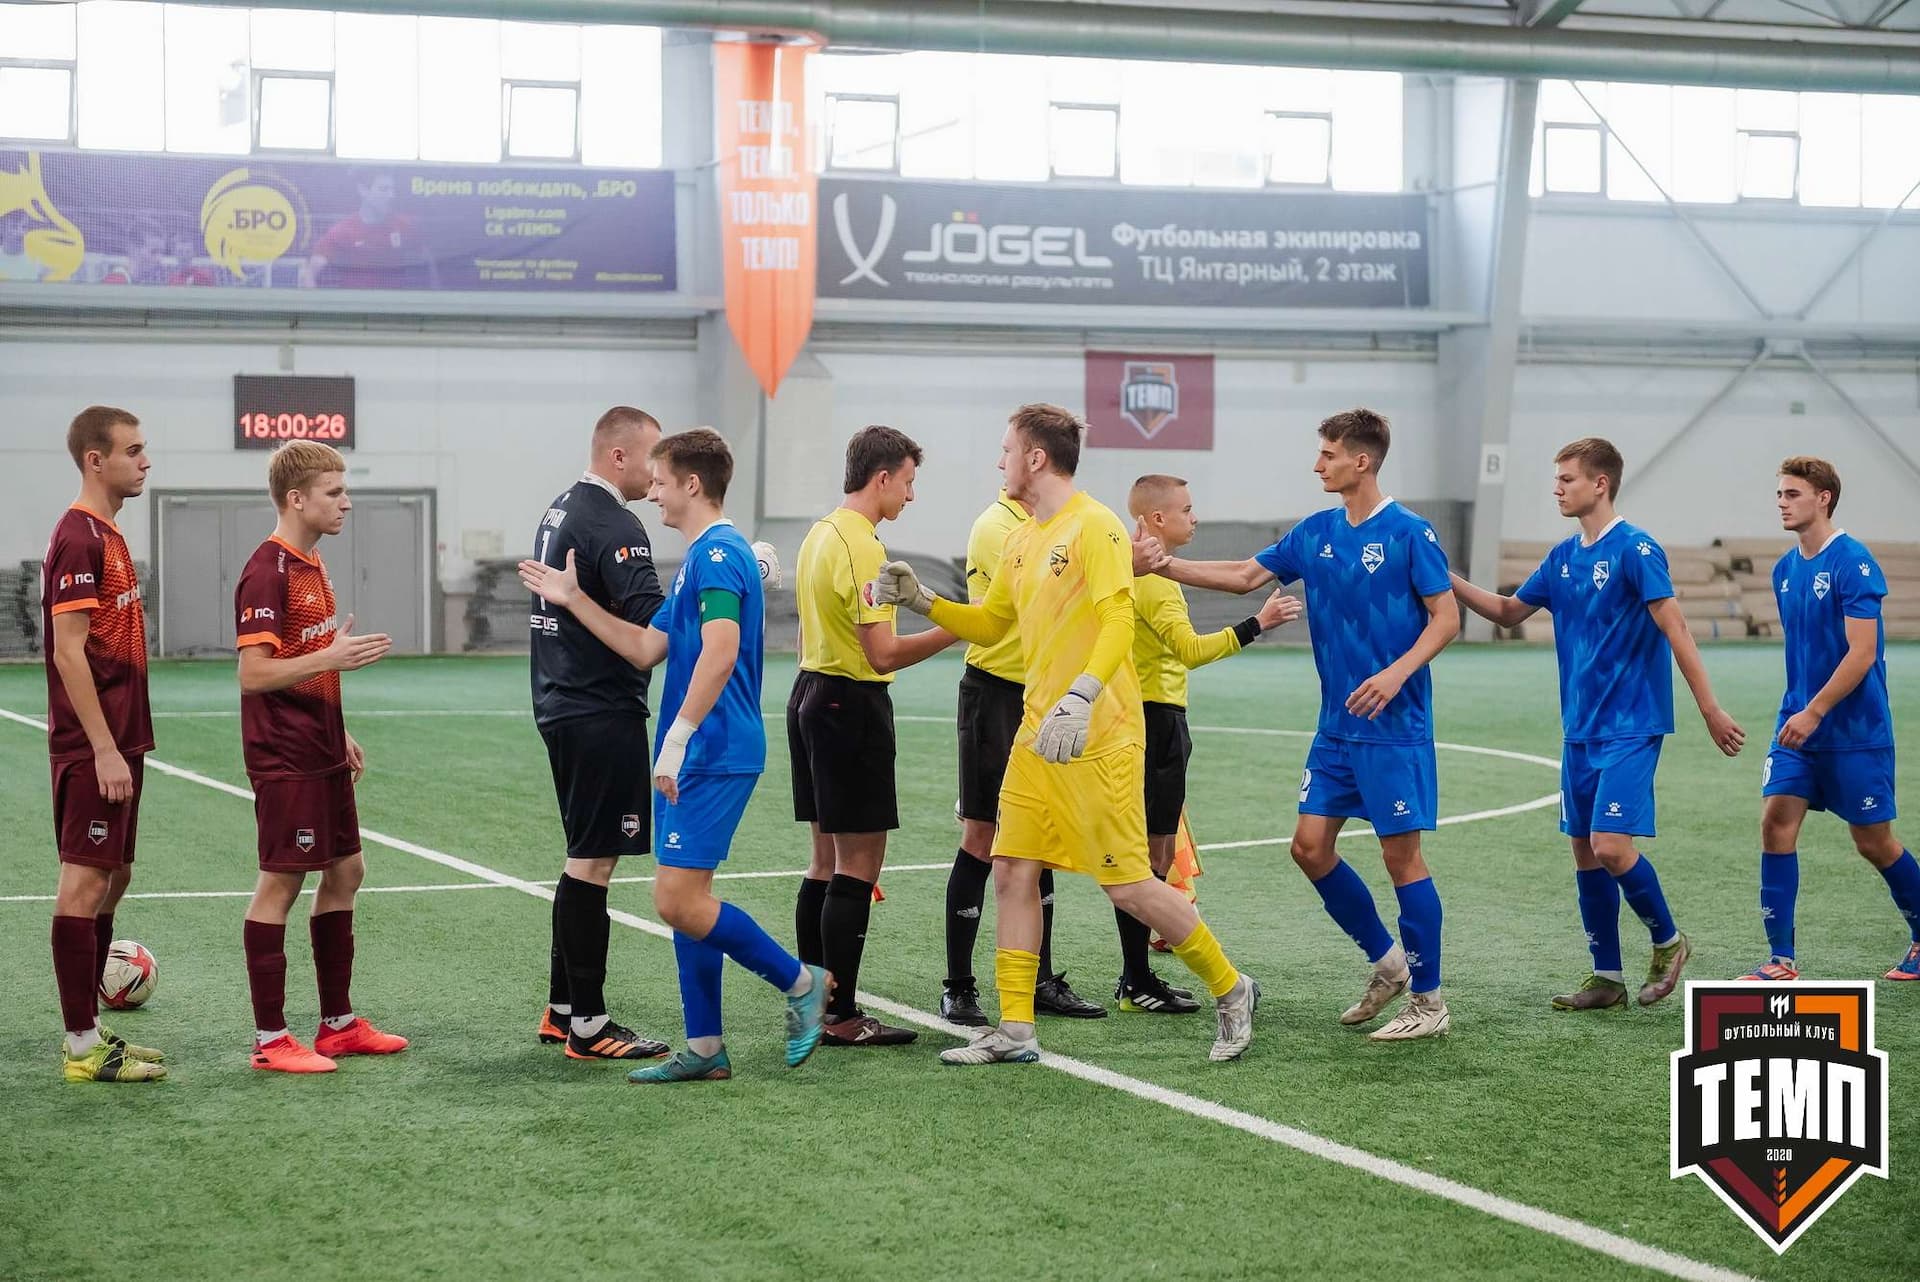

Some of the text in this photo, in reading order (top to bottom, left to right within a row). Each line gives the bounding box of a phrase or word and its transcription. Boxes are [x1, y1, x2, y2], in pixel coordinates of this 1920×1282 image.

[412, 176, 638, 200] Время побеждать, .БРО
[228, 209, 287, 231] .БРО
[728, 192, 809, 226] ТОЛЬКО
[903, 211, 1113, 267] JÖGEL
[1112, 222, 1421, 253] Футбольная экипировка
[1138, 256, 1396, 285] ТЦ Янтарный, 2 этаж
[240, 413, 346, 438] 18:00:26
